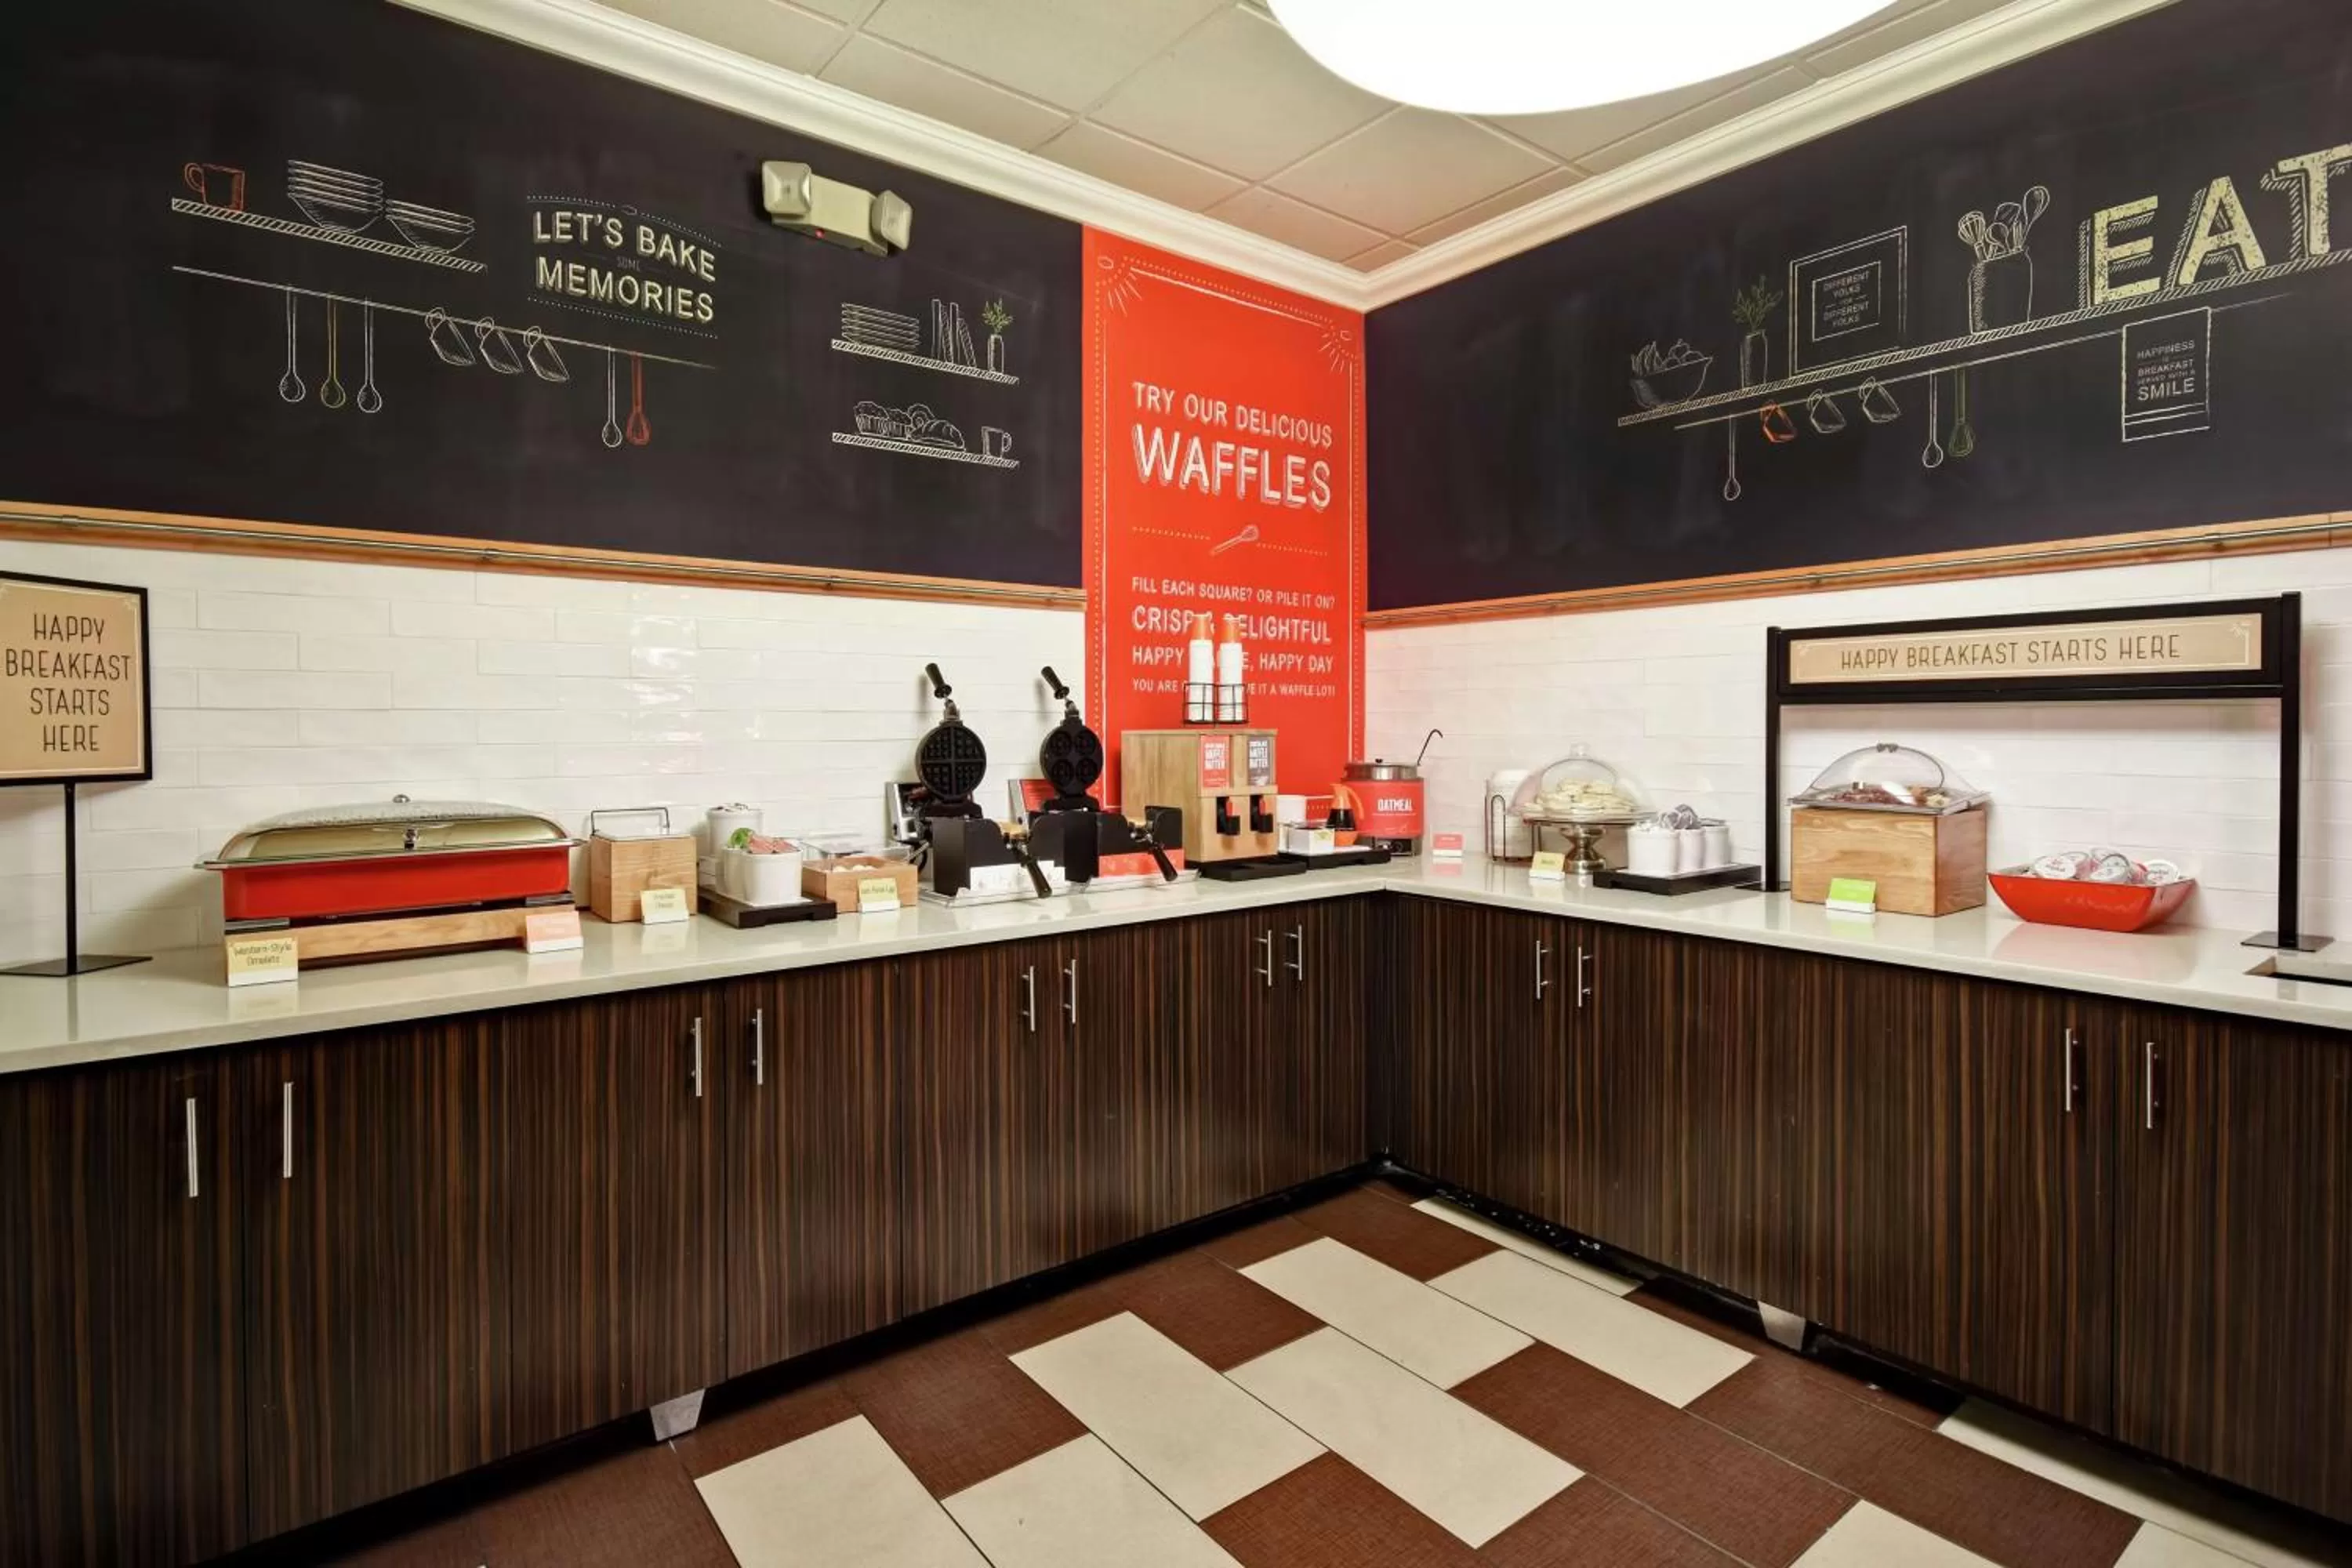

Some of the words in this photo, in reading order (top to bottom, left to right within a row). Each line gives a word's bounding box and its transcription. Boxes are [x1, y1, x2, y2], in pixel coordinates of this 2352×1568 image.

[2082, 143, 2352, 306] EAT
[533, 211, 624, 249] LET'S
[636, 224, 717, 283] BAKE
[536, 256, 714, 323] MEMORIES
[2136, 339, 2195, 360] HAPPINESS
[2138, 358, 2194, 377] BREAKFAST
[2138, 377, 2195, 401] SMILE
[1132, 381, 1175, 415] TRY
[1183, 394, 1228, 426] OUR
[1235, 405, 1333, 449] DELICIOUS
[1131, 423, 1331, 514] WAFFLES
[1131, 576, 1158, 594] FILL
[1161, 579, 1196, 597] EACH
[1198, 583, 1253, 602] SQUARE?
[1256, 589, 1273, 604] OR
[1276, 590, 1299, 608] PILE
[1301, 593, 1312, 608] IT
[1315, 594, 1336, 610] ON?
[33, 612, 105, 645] HAPPY
[1131, 604, 1193, 635] CRISP
[5, 648, 132, 681] BREAKFAST
[1132, 645, 1185, 667] HAPPY
[1259, 652, 1305, 672] HAPPY
[1308, 654, 1334, 674] DAY
[1842, 647, 1899, 670] HAPPY
[1907, 642, 2019, 668] BREAKFAST
[2027, 637, 2108, 663] STARTS
[2119, 634, 2181, 659] HERE
[30, 688, 111, 716] STARTS
[1132, 677, 1154, 691] YOU
[1156, 678, 1178, 693] ARE
[1258, 682, 1268, 695] IT
[1269, 683, 1277, 695] A
[43, 725, 100, 752] HERE
[1377, 798, 1413, 811] OATMEAL
